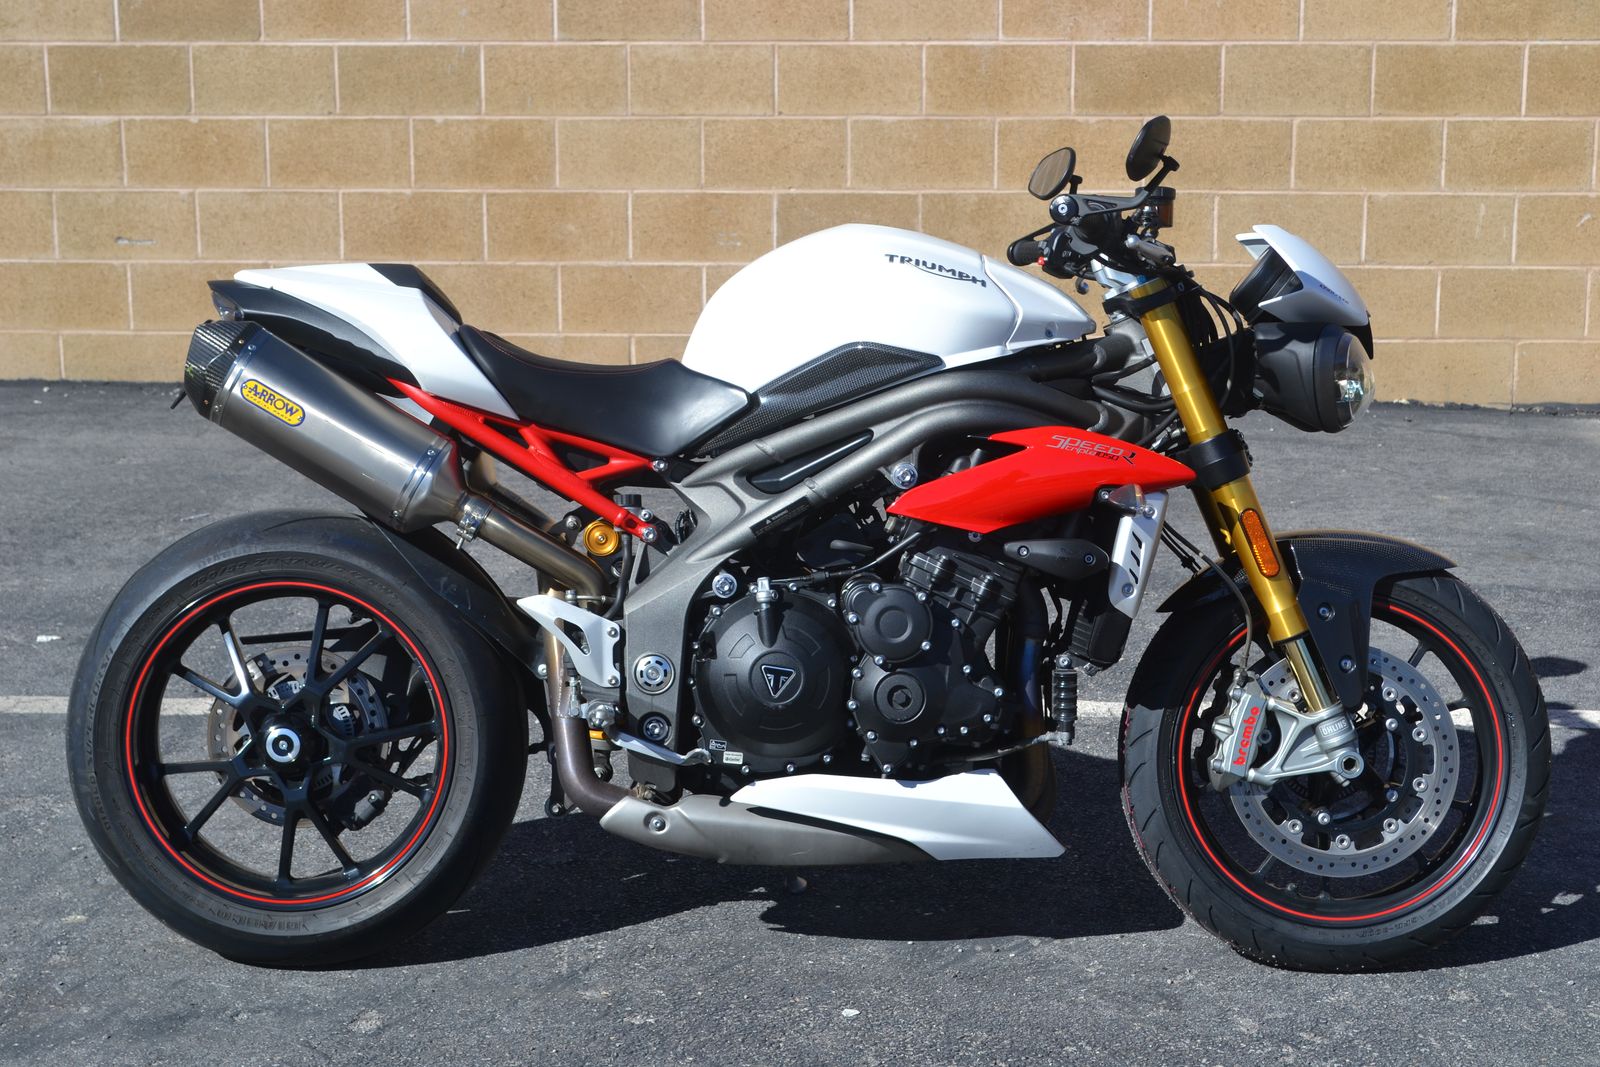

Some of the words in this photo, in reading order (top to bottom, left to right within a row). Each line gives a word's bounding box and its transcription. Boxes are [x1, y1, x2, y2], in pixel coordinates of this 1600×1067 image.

[884, 253, 987, 288] TRIUMPH
[247, 383, 300, 417] ARROW
[1045, 434, 1125, 456] SPEED
[1233, 706, 1261, 766] brembo
